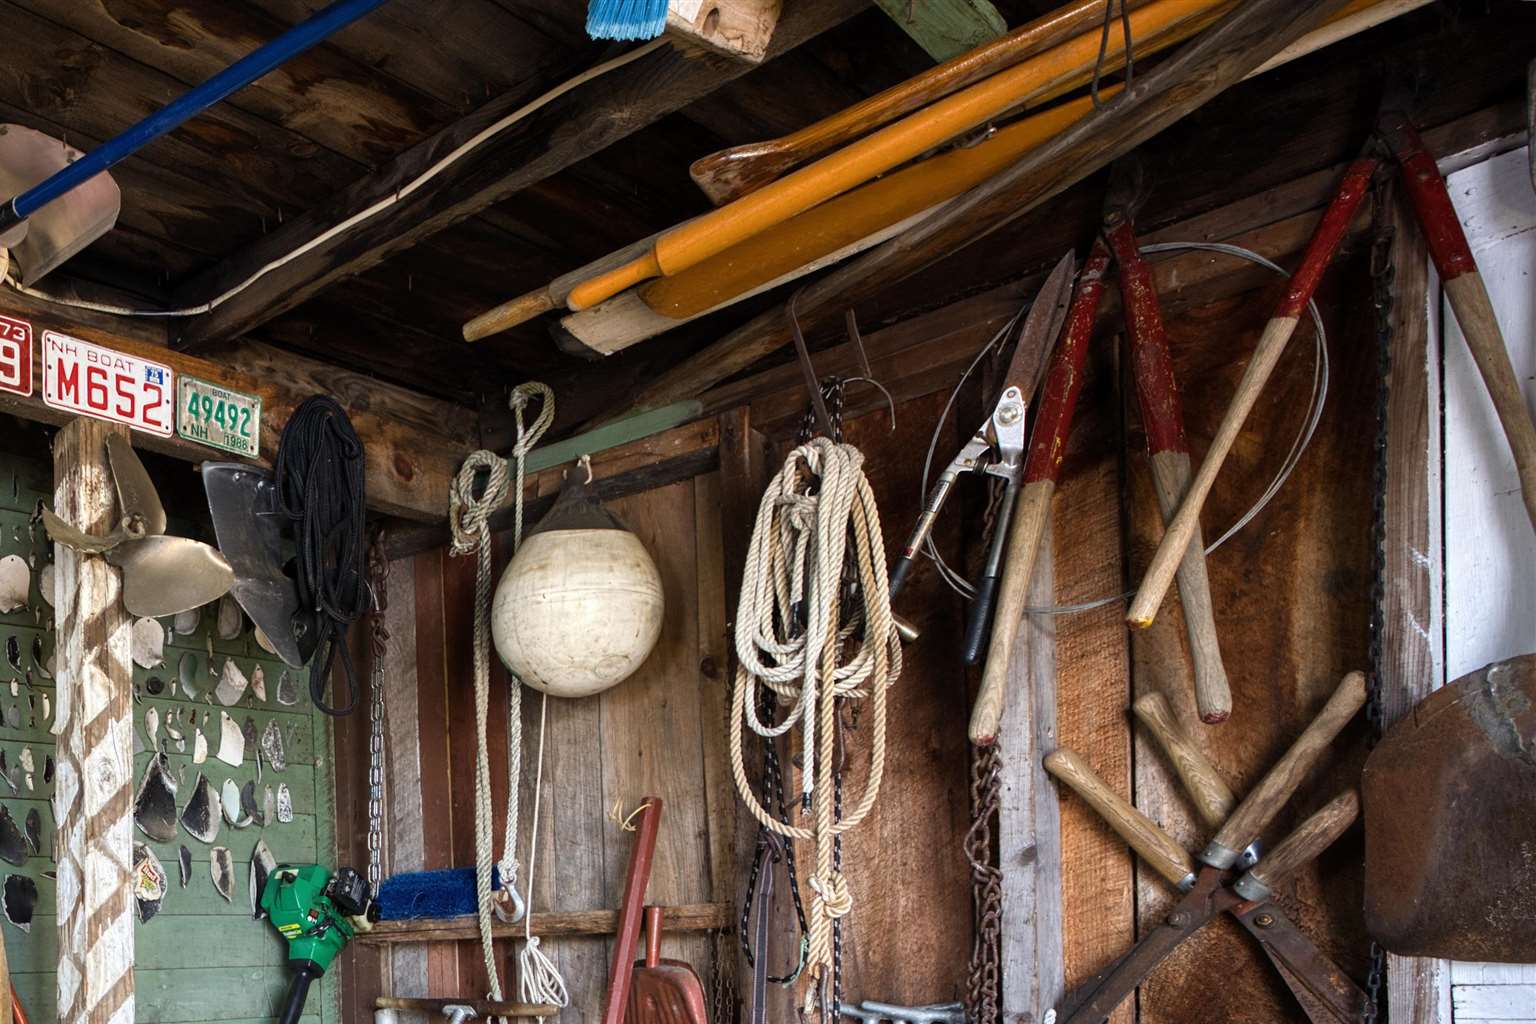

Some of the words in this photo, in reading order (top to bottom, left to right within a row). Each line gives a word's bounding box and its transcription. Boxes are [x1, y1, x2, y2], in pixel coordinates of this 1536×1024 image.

[50, 339, 78, 357] NH
[87, 348, 134, 373] BOAT
[57, 357, 162, 427] M652
[212, 388, 231, 400] BOAT
[188, 391, 251, 437] 49492
[191, 423, 208, 440] NH
